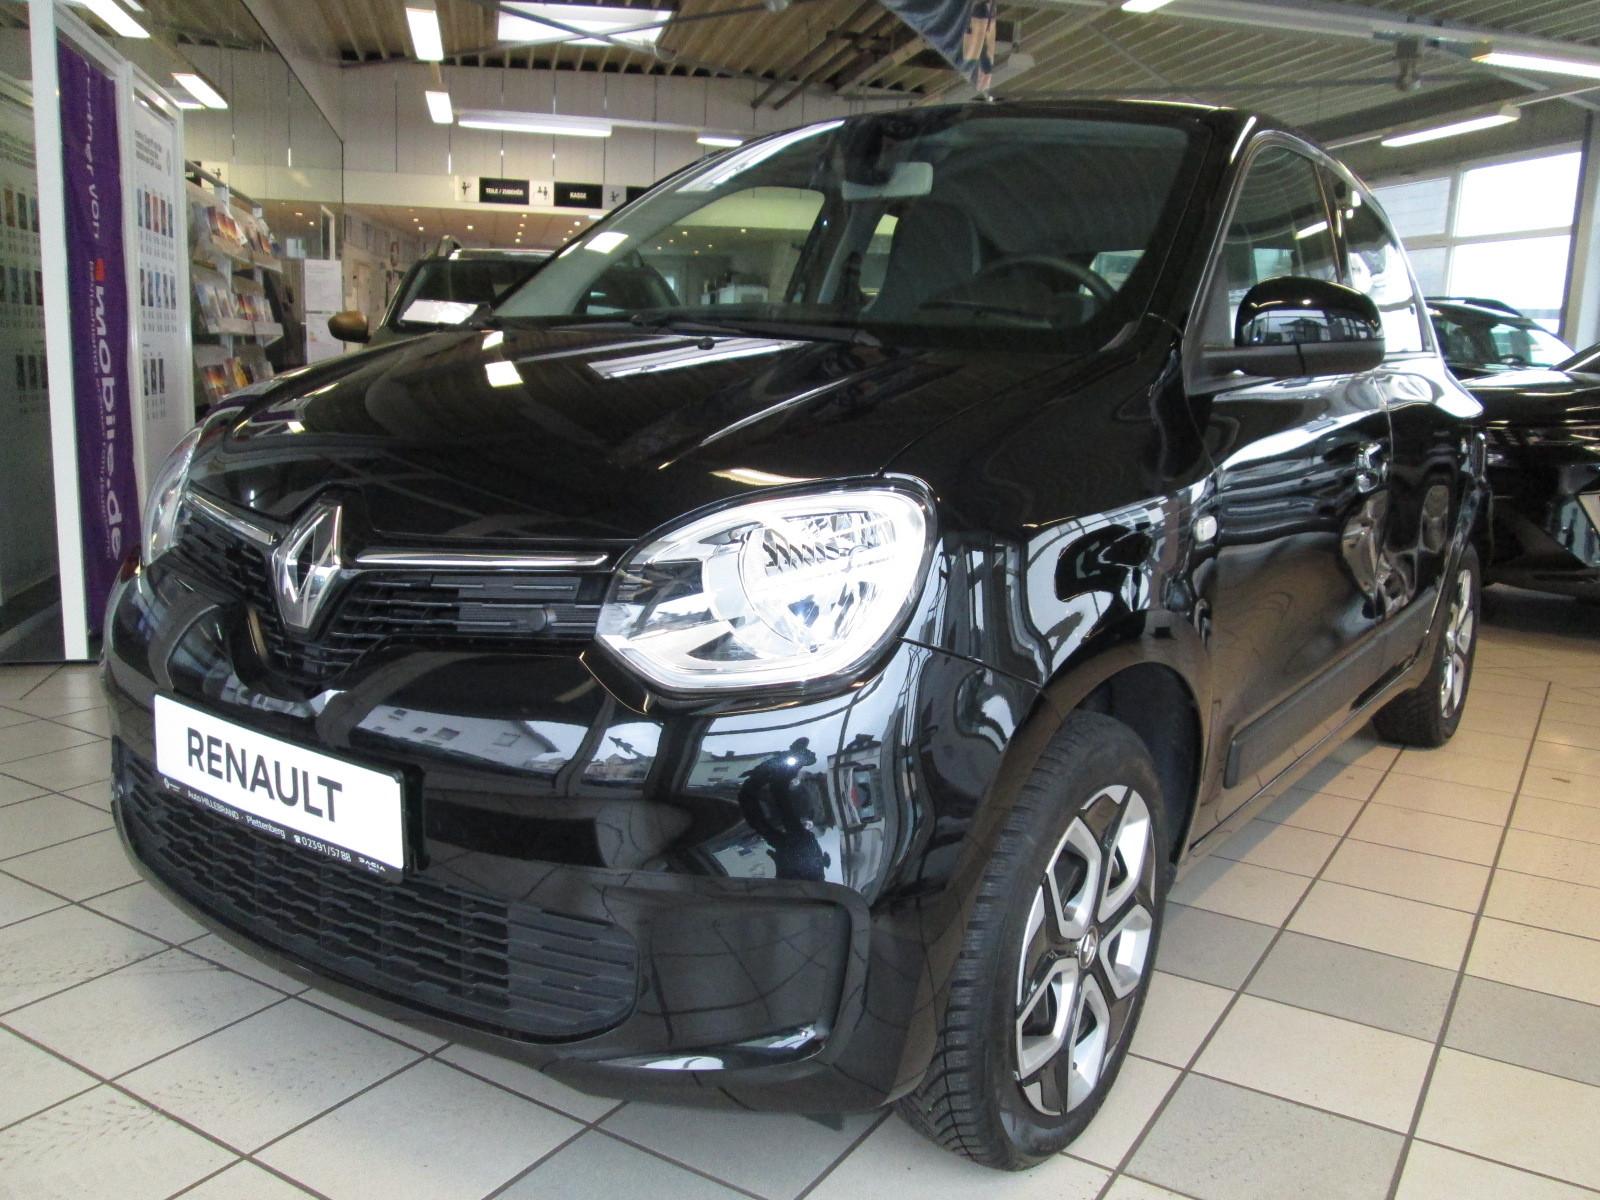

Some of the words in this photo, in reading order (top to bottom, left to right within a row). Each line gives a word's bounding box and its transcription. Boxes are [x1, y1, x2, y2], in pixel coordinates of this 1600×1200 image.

[95, 285, 122, 561] mobile.de
[187, 727, 342, 822] RENAULT
[245, 815, 286, 840] Plettenberg
[301, 836, 352, 863] 02391/5788
